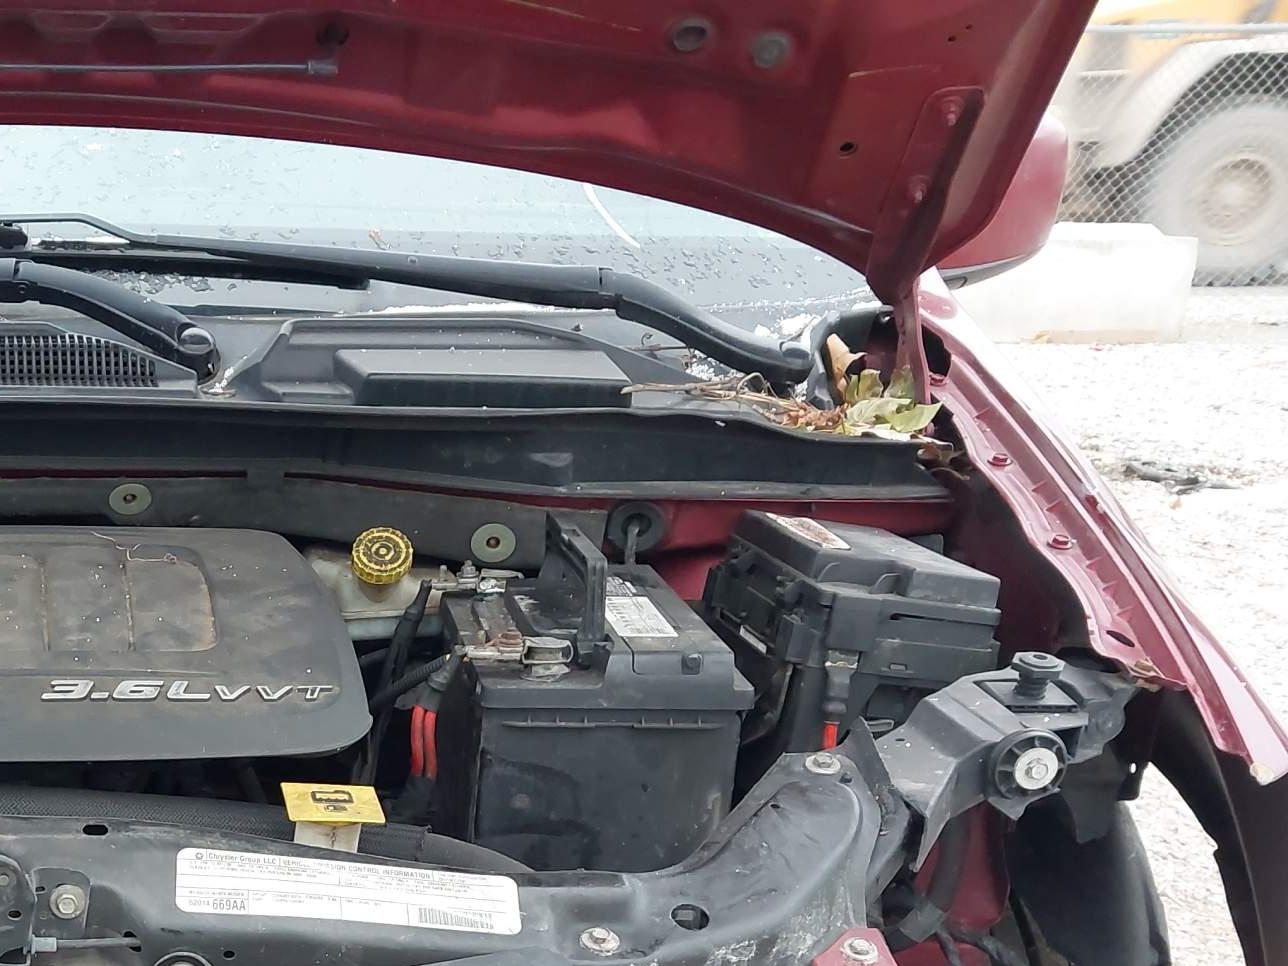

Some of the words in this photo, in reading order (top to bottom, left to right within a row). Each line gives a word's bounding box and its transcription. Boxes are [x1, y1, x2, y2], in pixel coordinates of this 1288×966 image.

[208, 852, 238, 863] Chrysler
[239, 855, 261, 866] Group
[263, 857, 277, 865] LLC
[348, 865, 380, 875] CONTROL
[382, 868, 431, 880] INFORMATION
